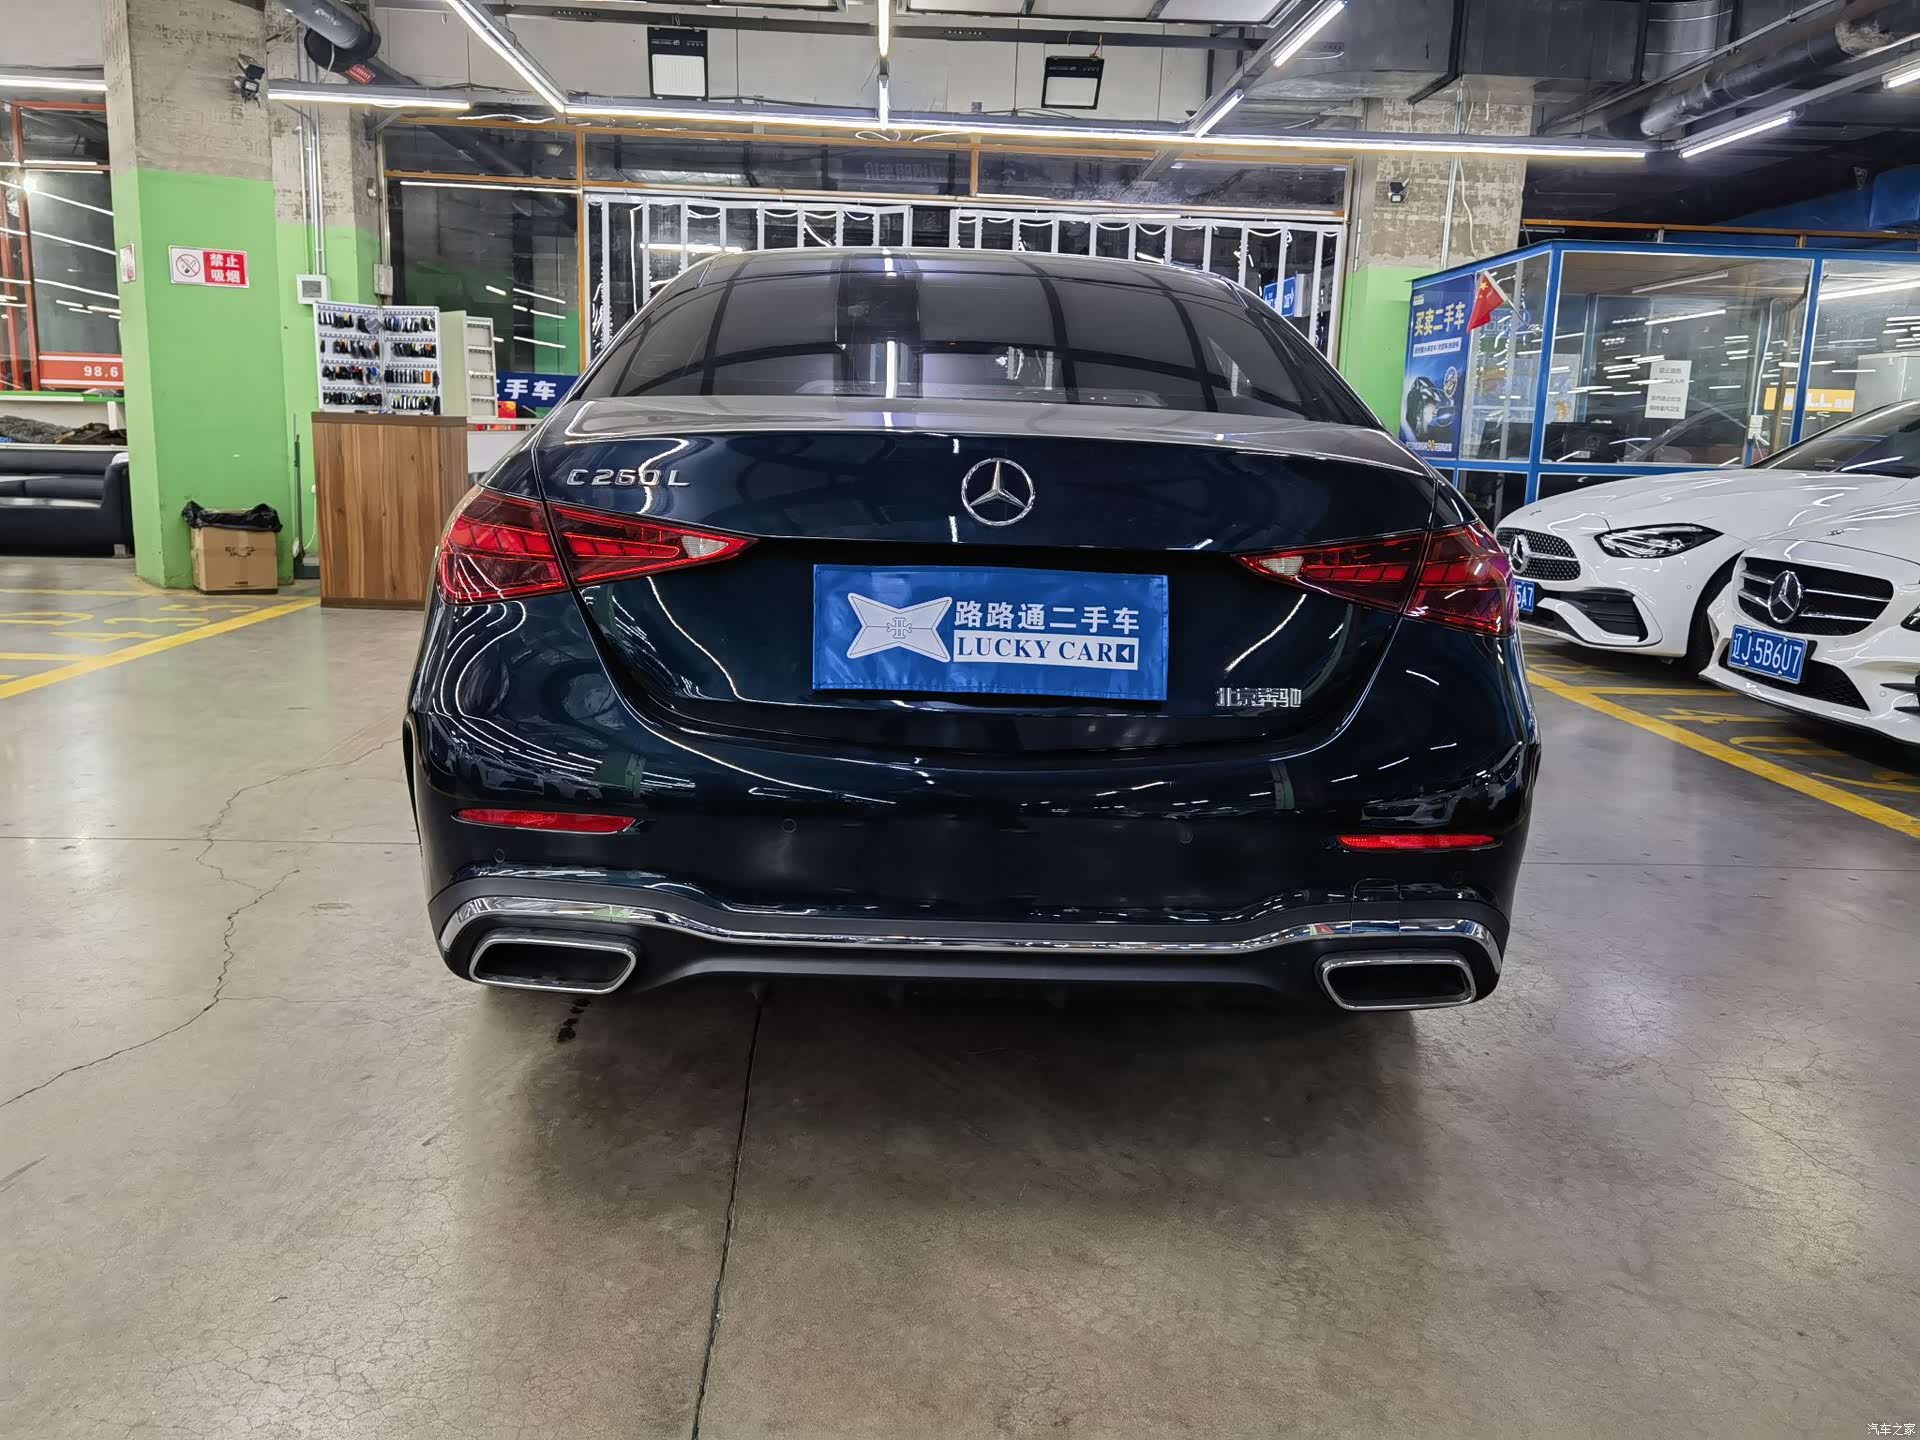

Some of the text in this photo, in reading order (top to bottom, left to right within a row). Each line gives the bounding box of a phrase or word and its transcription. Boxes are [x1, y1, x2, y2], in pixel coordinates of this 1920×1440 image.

[209, 253, 240, 268] 禁止
[210, 269, 241, 284] 吸烟
[1413, 301, 1466, 337] 买卖二手车
[83, 365, 119, 378] 98.6
[496, 379, 557, 400] 手车
[954, 600, 1140, 635] 路路通二手车
[956, 636, 1114, 663] LUCKY CAR
[1215, 687, 1302, 708] 北京奔驰
